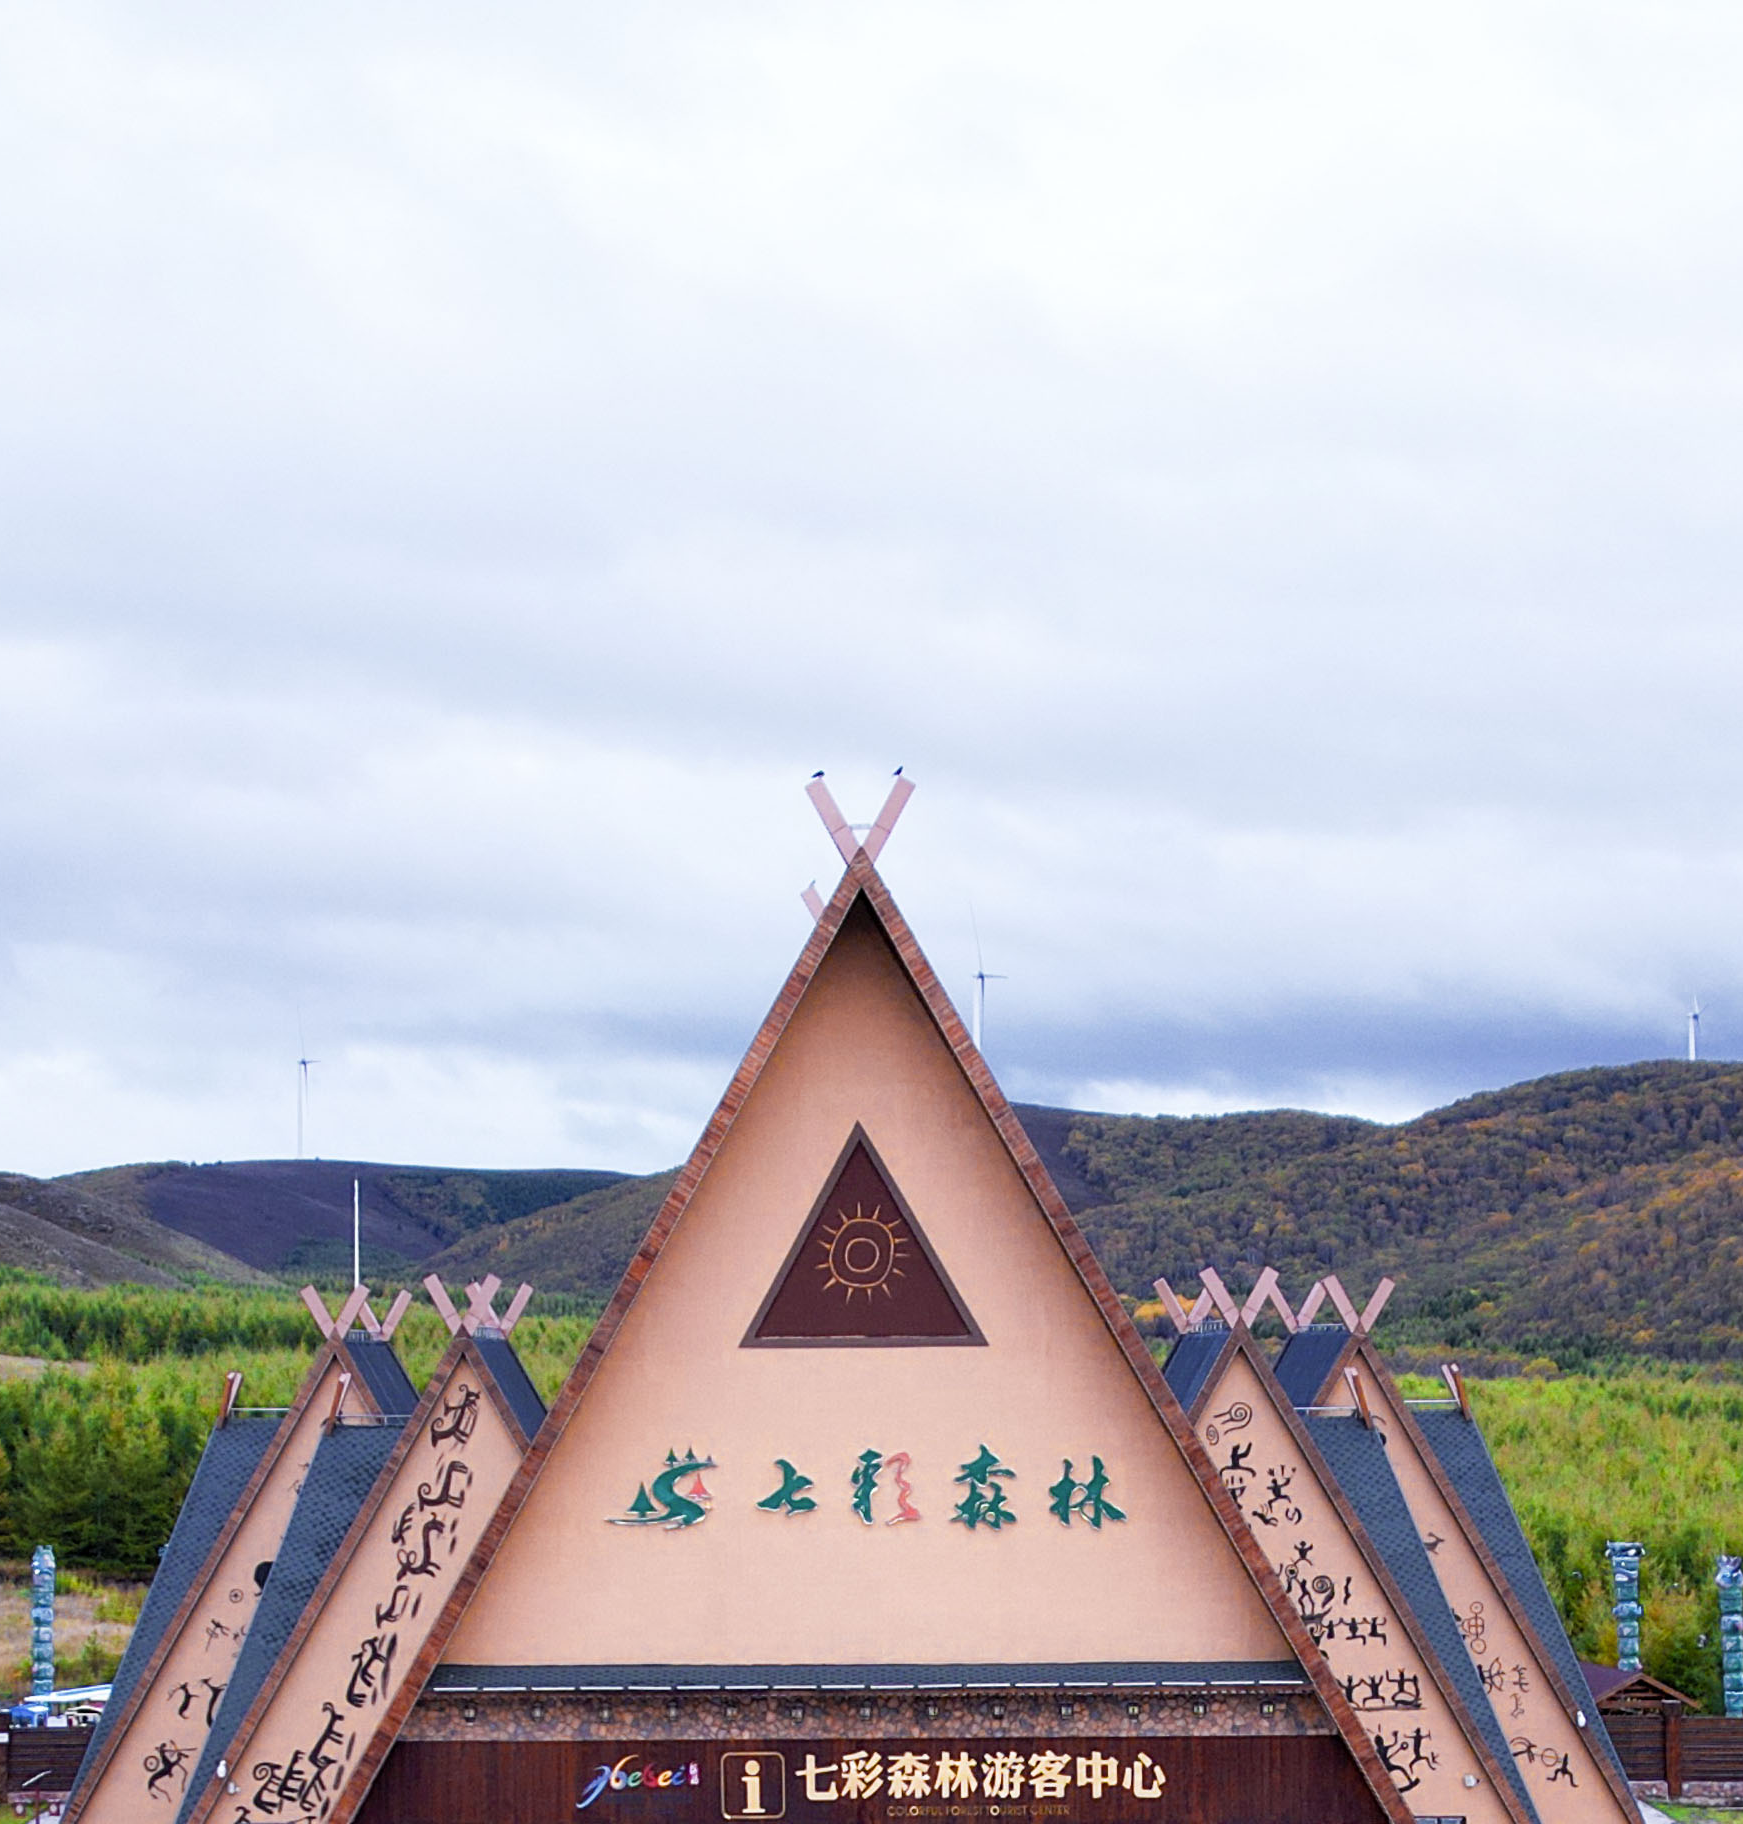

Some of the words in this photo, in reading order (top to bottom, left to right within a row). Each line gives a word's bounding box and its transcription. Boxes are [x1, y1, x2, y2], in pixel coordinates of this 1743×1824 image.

[756, 1443, 1127, 1531] 七彩森林
[795, 1750, 1167, 1801] 七彩森林游客中心
